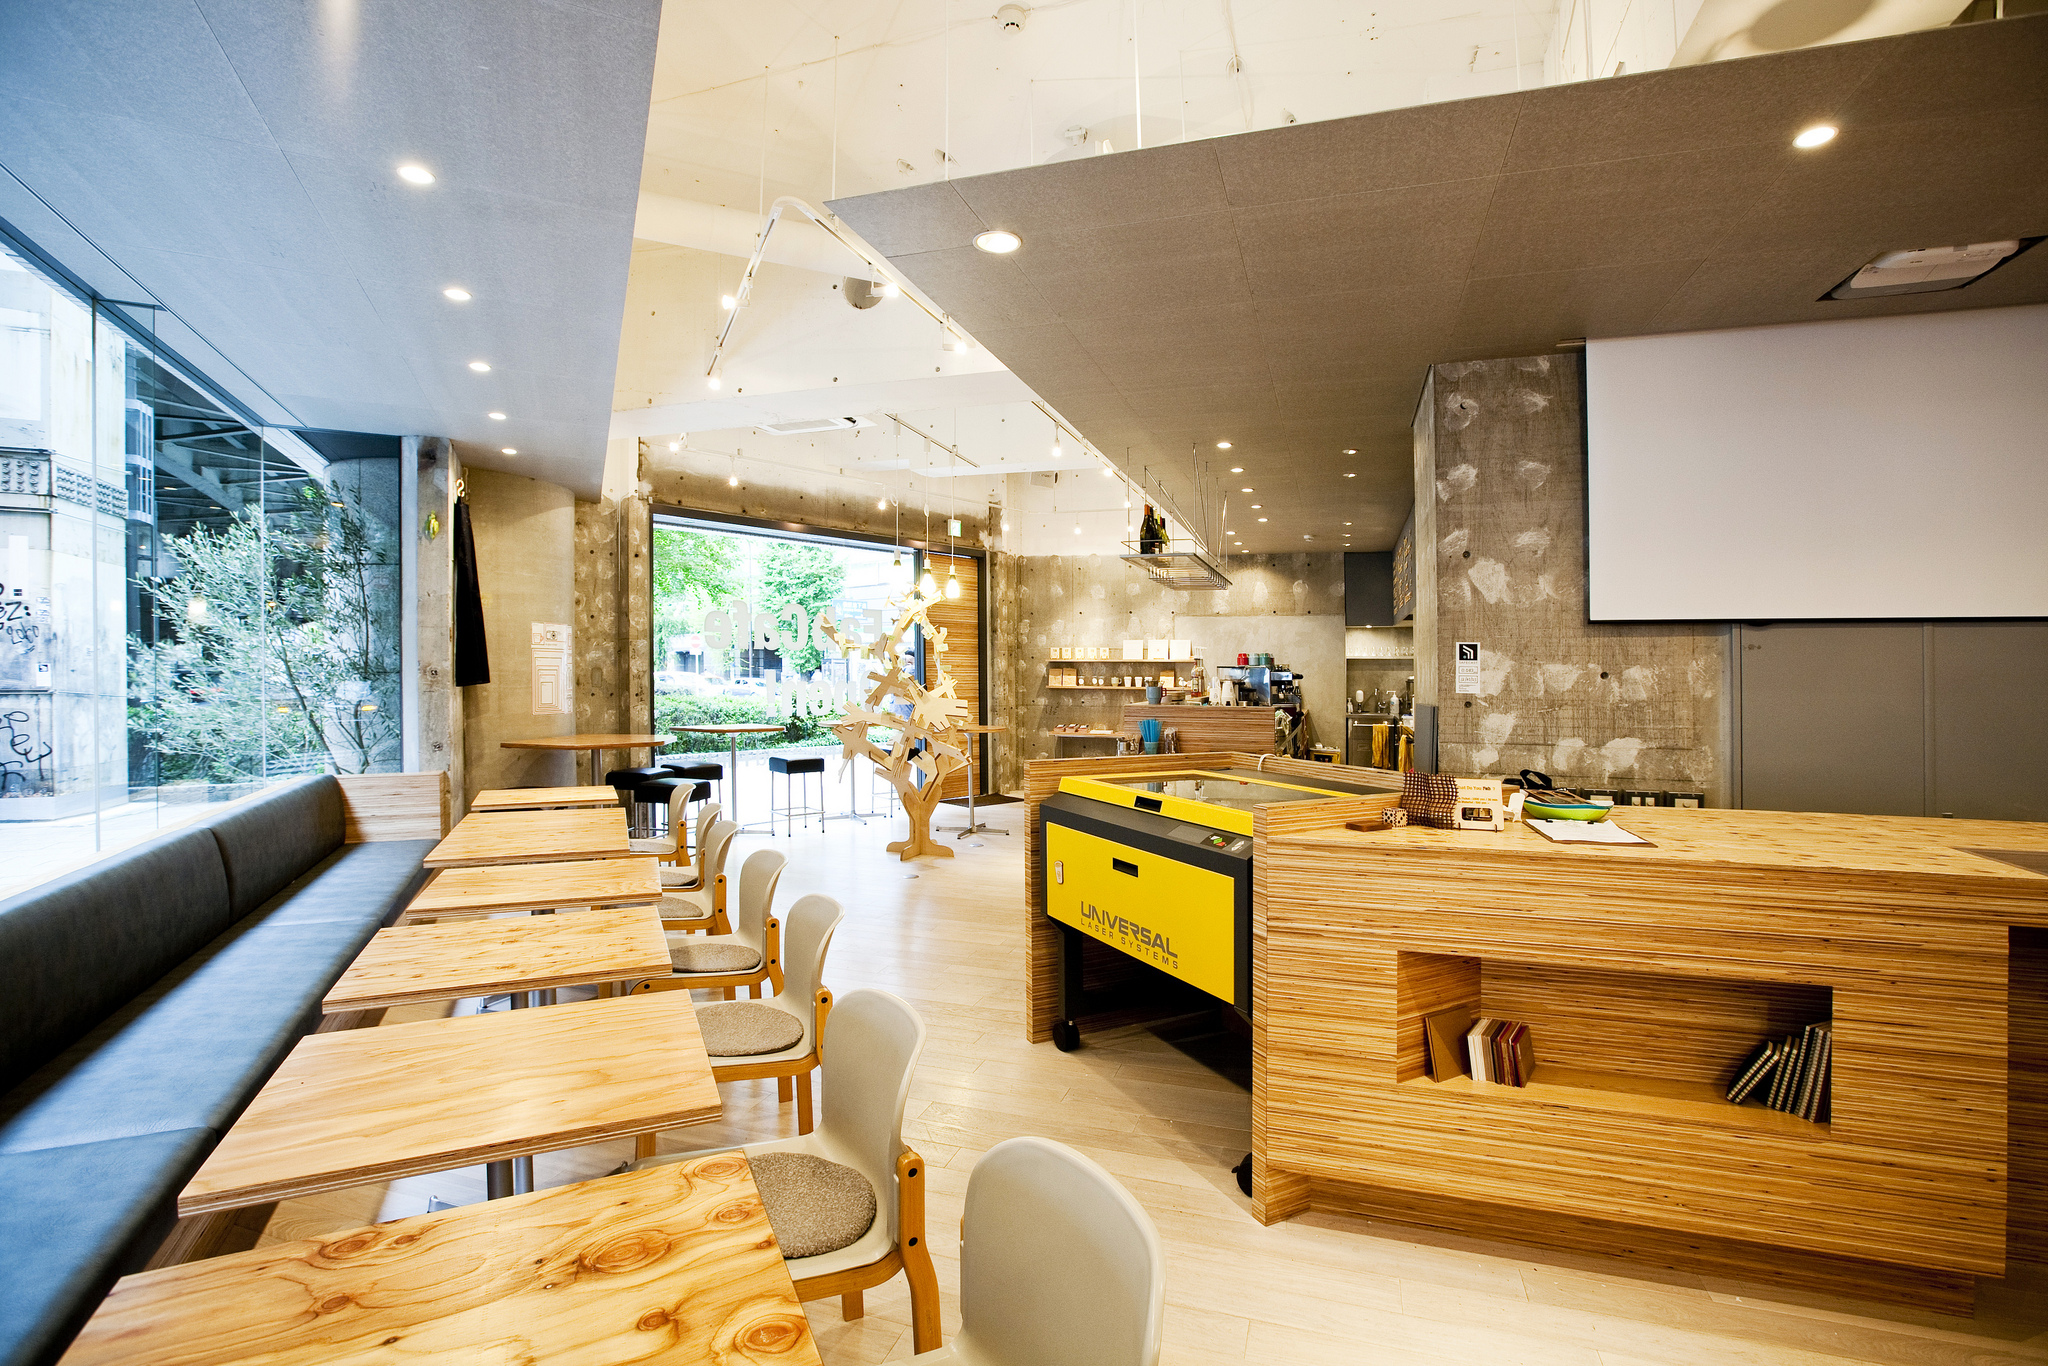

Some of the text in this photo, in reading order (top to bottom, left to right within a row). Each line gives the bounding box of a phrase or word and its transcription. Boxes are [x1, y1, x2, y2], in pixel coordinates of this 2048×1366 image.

[1081, 901, 1178, 959] UNIVERSAL
[1081, 918, 1179, 970] LASER SYSTEMS
